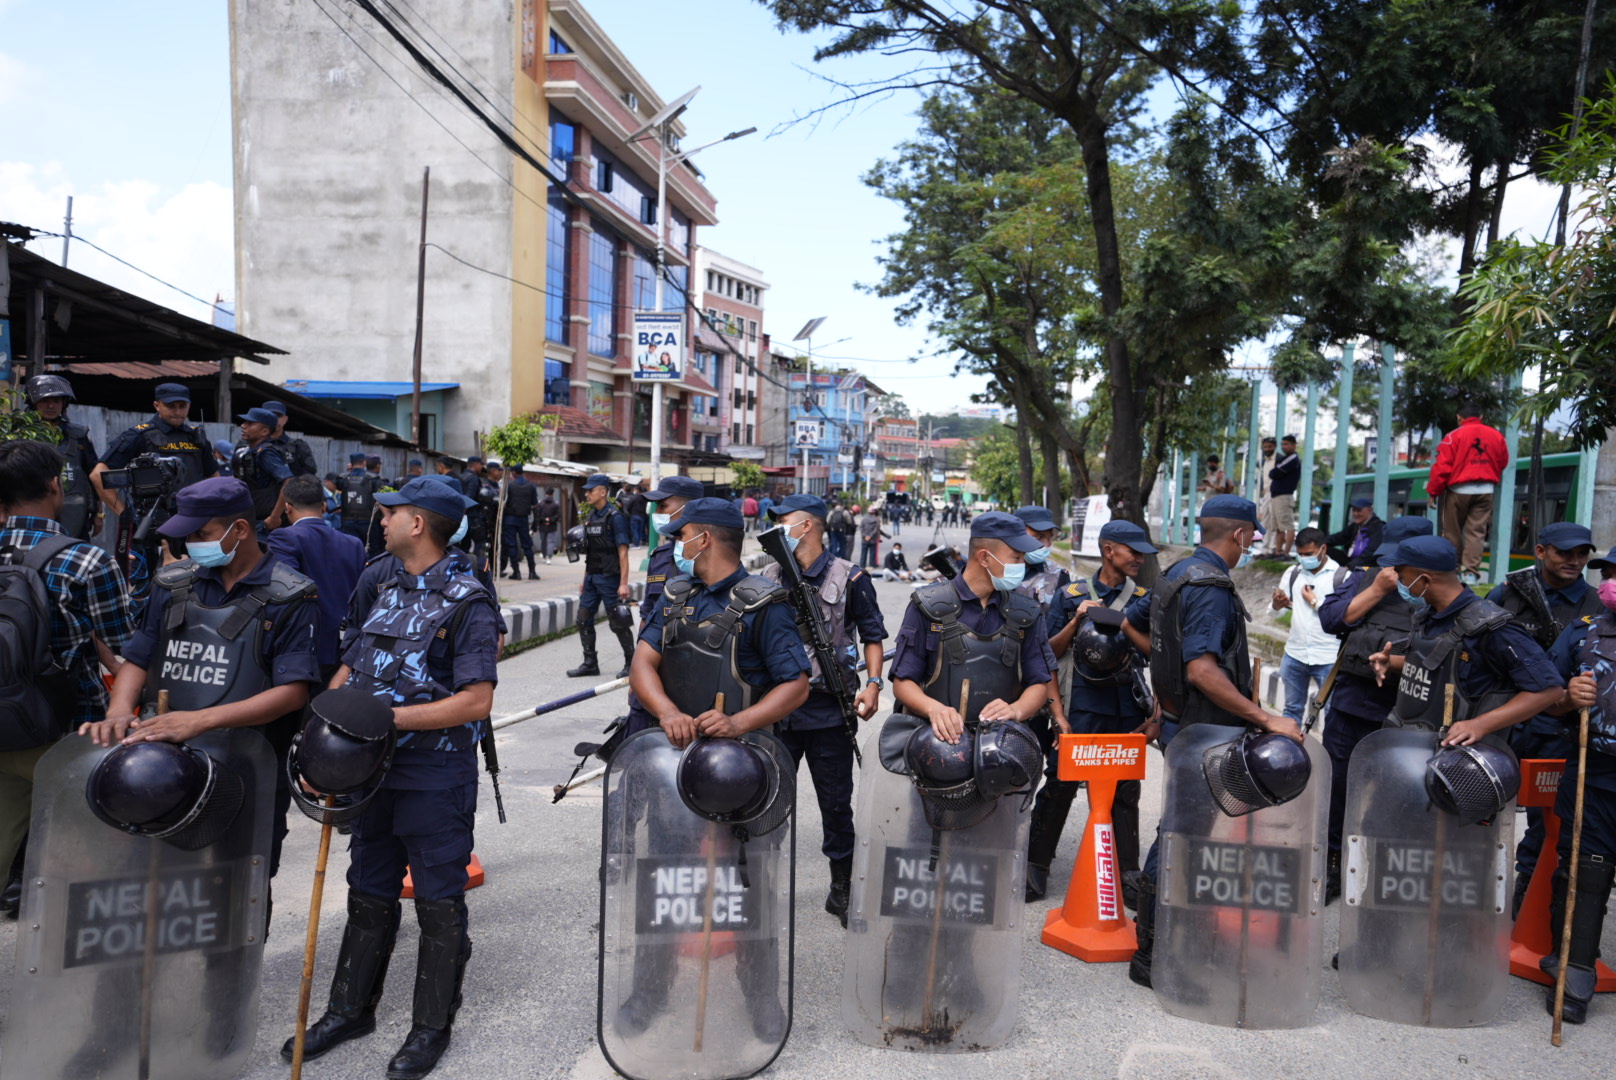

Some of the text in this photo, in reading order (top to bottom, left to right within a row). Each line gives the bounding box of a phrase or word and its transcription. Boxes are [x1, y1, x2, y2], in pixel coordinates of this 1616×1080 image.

[638, 332, 677, 346] BCA
[119, 529, 128, 554] Canon
[166, 639, 230, 665] NEPAL
[161, 661, 228, 686] POLICE
[1071, 744, 1139, 759] Hilltake
[1074, 759, 1101, 767] TANKS
[1536, 771, 1561, 786] Hill
[656, 866, 744, 894] NEPAL
[1097, 830, 1115, 917] Hilltake
[1381, 876, 1479, 905] POLCE
[655, 895, 743, 925] POLCE
